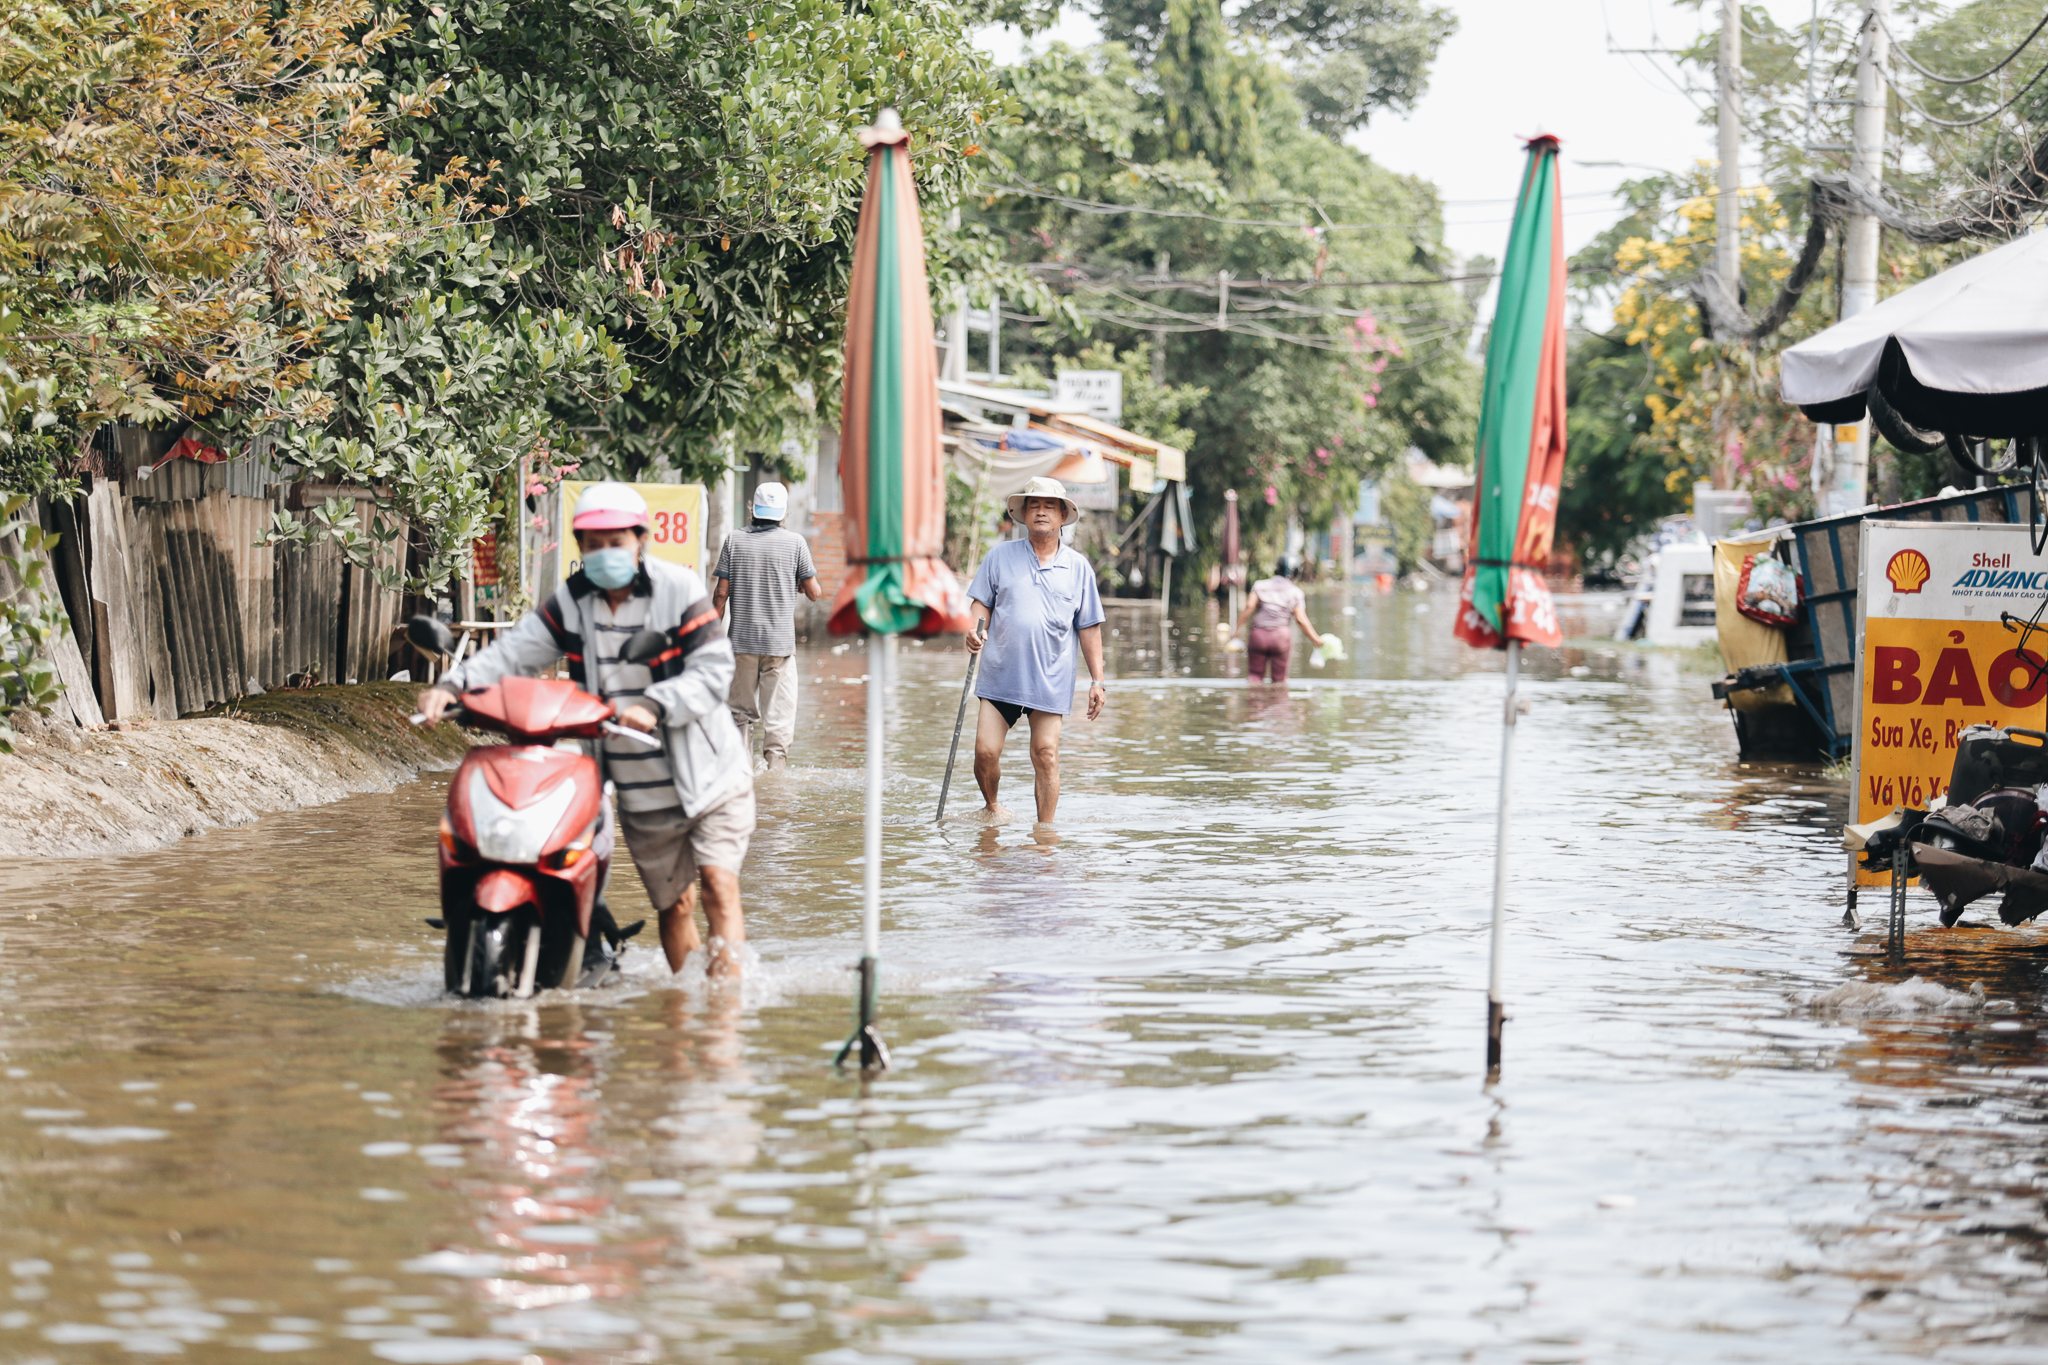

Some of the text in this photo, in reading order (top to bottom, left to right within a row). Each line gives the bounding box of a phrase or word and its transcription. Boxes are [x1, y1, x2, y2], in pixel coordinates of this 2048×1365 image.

[652, 510, 690, 546] 38
[1972, 552, 2011, 569] Shell
[1952, 569, 2048, 590] ADVANC
[1872, 630, 2048, 709] BẢO
[1908, 718, 1939, 755] Xe,
[1869, 775, 1893, 806] Vá
[1898, 775, 1922, 807] Vỏ
